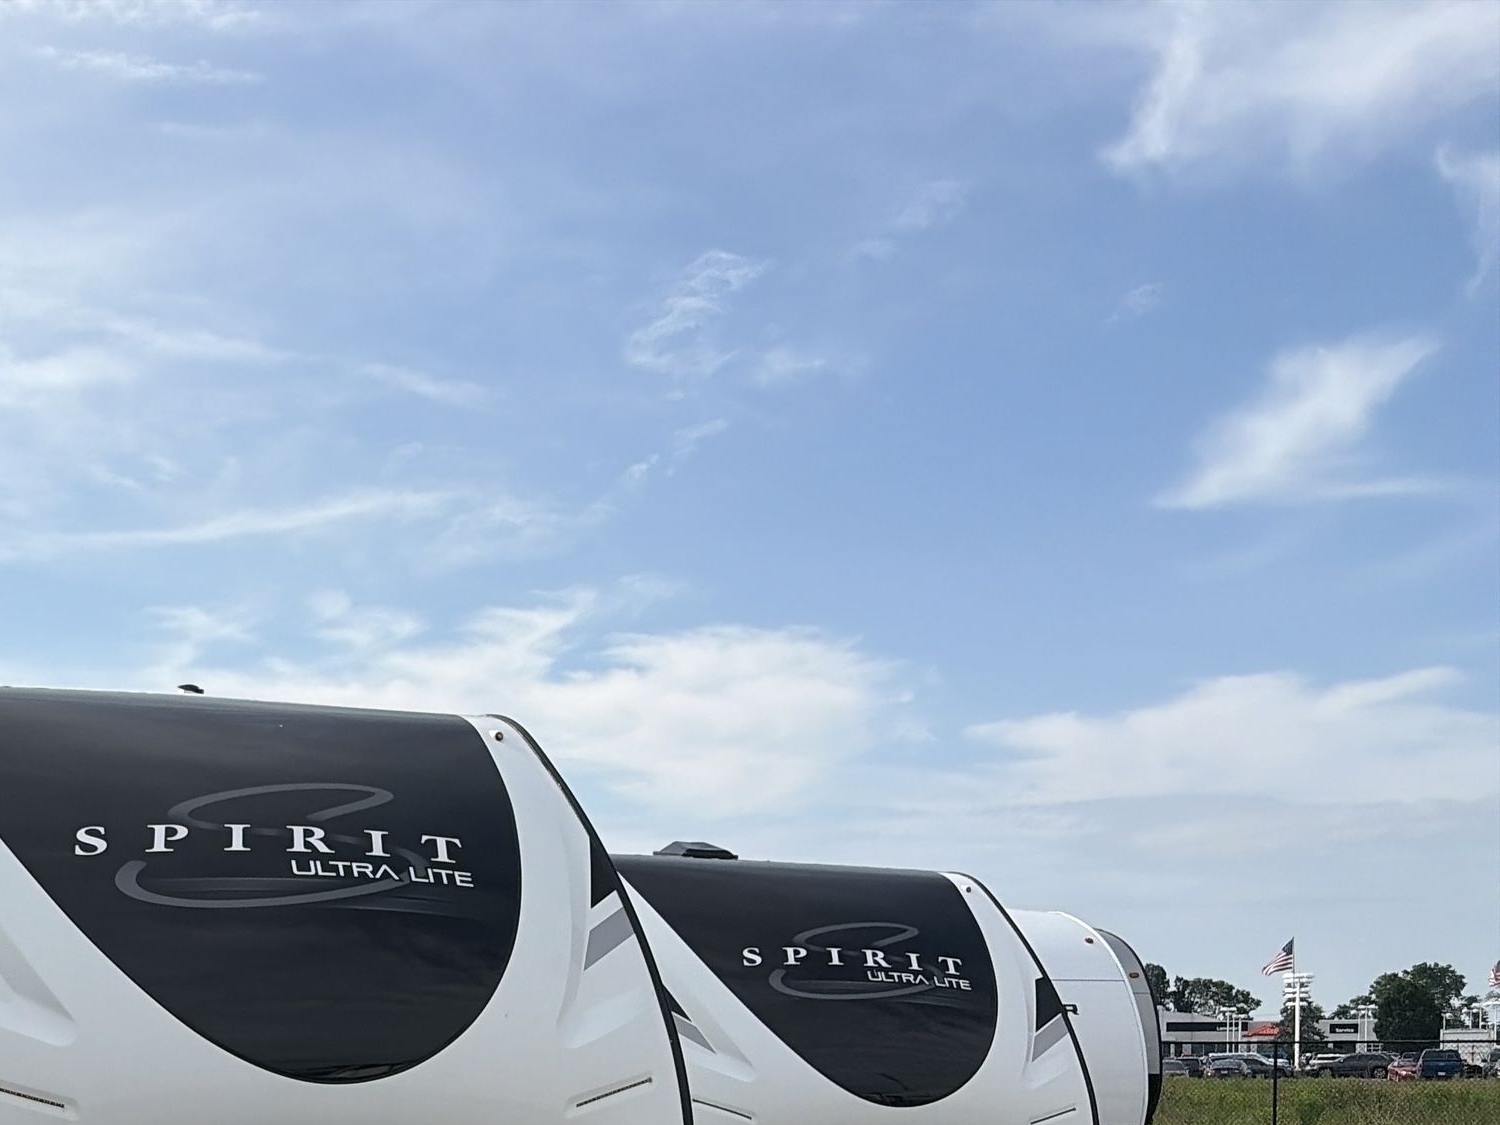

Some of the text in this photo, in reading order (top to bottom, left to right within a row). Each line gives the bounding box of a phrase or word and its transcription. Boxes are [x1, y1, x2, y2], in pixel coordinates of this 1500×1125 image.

[74, 823, 462, 863] SPIRIT
[291, 858, 474, 888] ULTRA LITE
[742, 946, 963, 976] SPIRIT
[867, 970, 972, 991] ULTRA LITE
